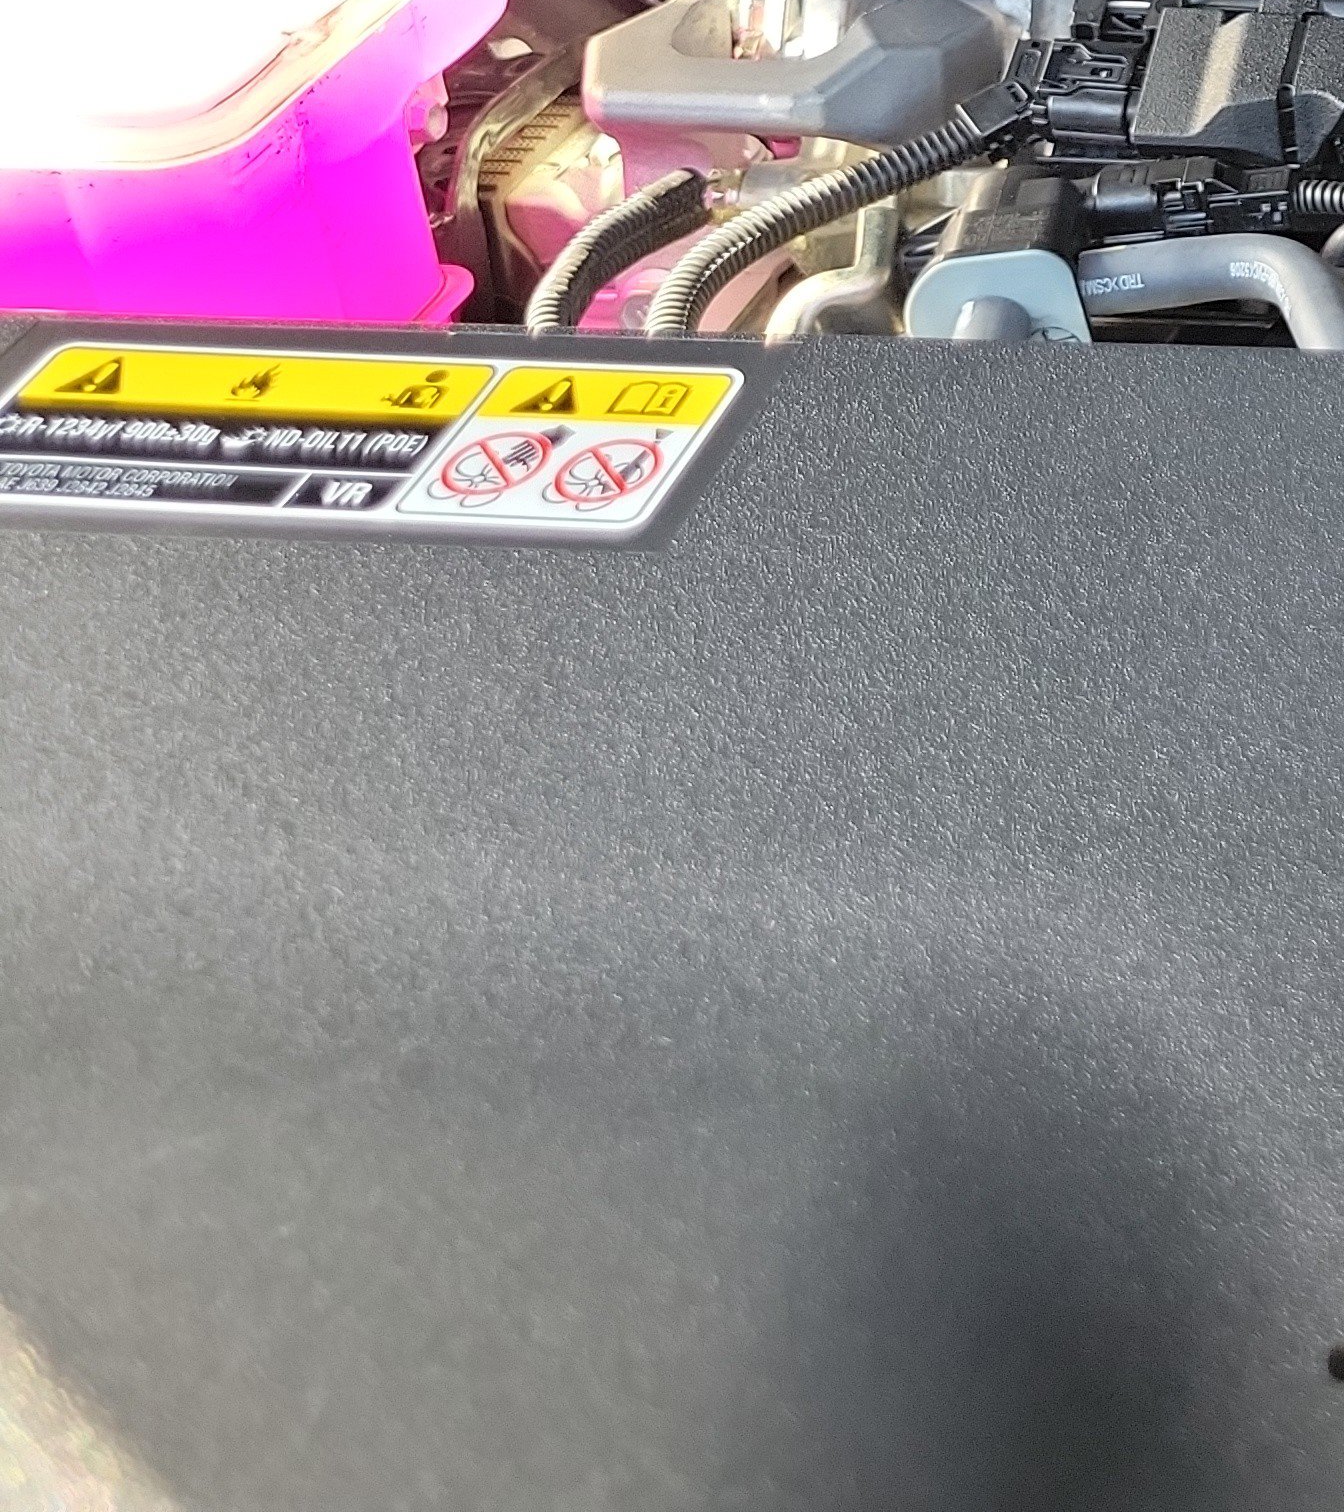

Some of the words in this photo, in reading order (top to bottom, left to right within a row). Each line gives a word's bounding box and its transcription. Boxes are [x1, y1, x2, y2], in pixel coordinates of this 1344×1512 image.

[16, 415, 127, 440] R-1234yf
[121, 420, 221, 446] 900±30g
[264, 428, 367, 449] ND-OIL11
[363, 432, 429, 456] (POE)
[0, 462, 61, 477] TOYOTA
[61, 465, 124, 481] MOTOR
[122, 469, 240, 488] CORPORATION
[105, 483, 159, 498] J2845
[322, 480, 374, 507] VR
